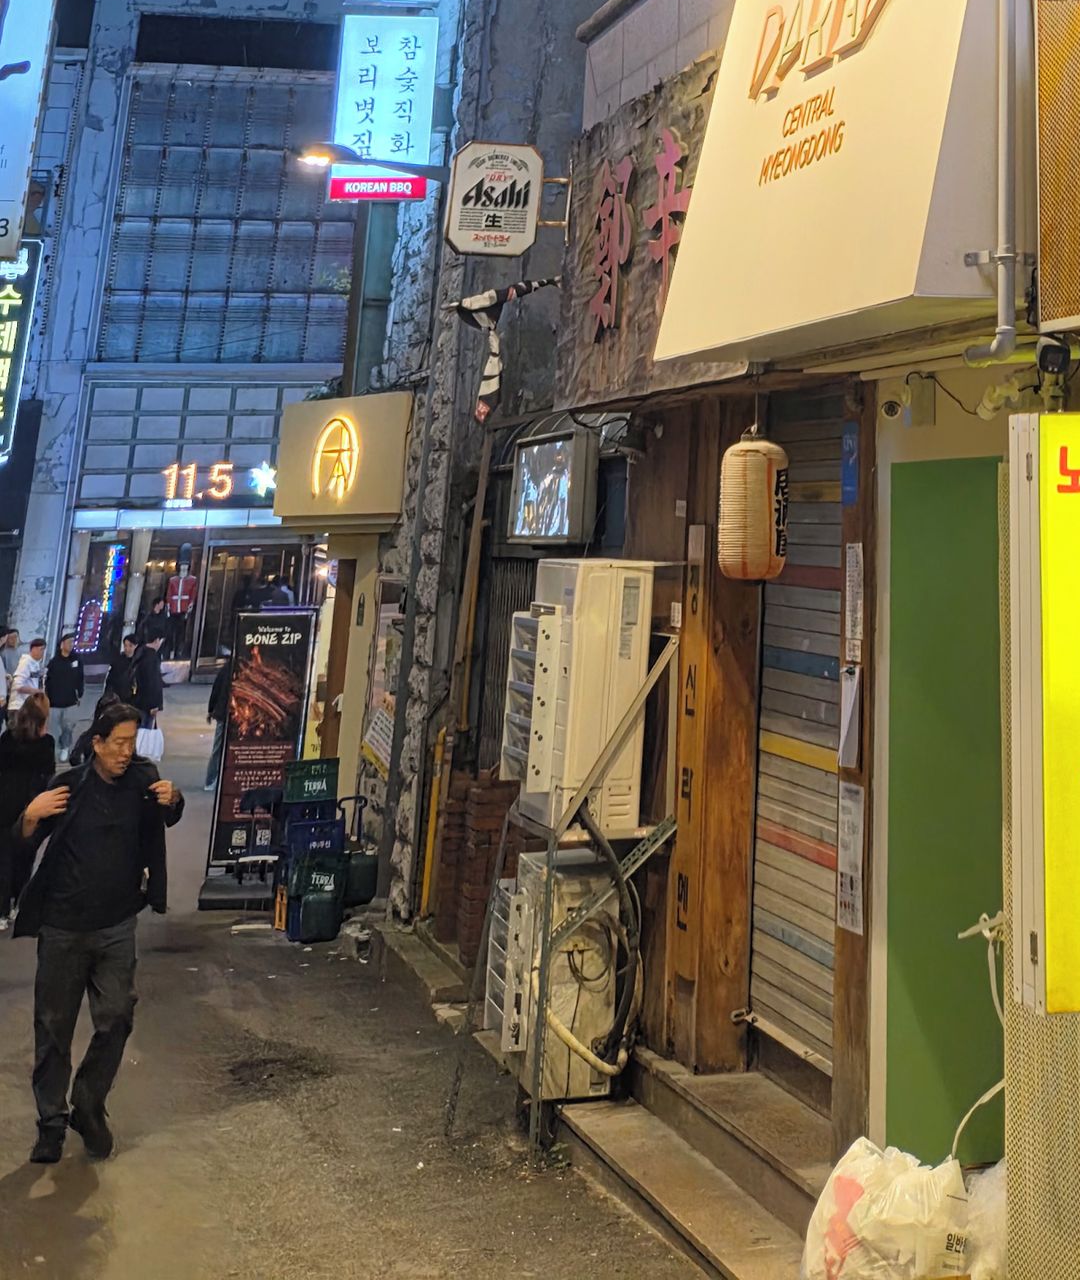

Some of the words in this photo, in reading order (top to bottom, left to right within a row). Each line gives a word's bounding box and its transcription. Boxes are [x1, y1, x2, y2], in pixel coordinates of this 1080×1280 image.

[351, 34, 383, 160] 보리볏짚
[390, 34, 422, 157] 참숯직화
[782, 85, 836, 139] CENTRAL
[758, 120, 846, 187] MYEONGDONG
[344, 181, 389, 193] KOREAN
[391, 181, 413, 195] BBQ
[462, 177, 531, 209] Asahi
[485, 213, 503, 229] 生
[245, 633, 279, 645] BONE
[281, 632, 302, 645] ZIP
